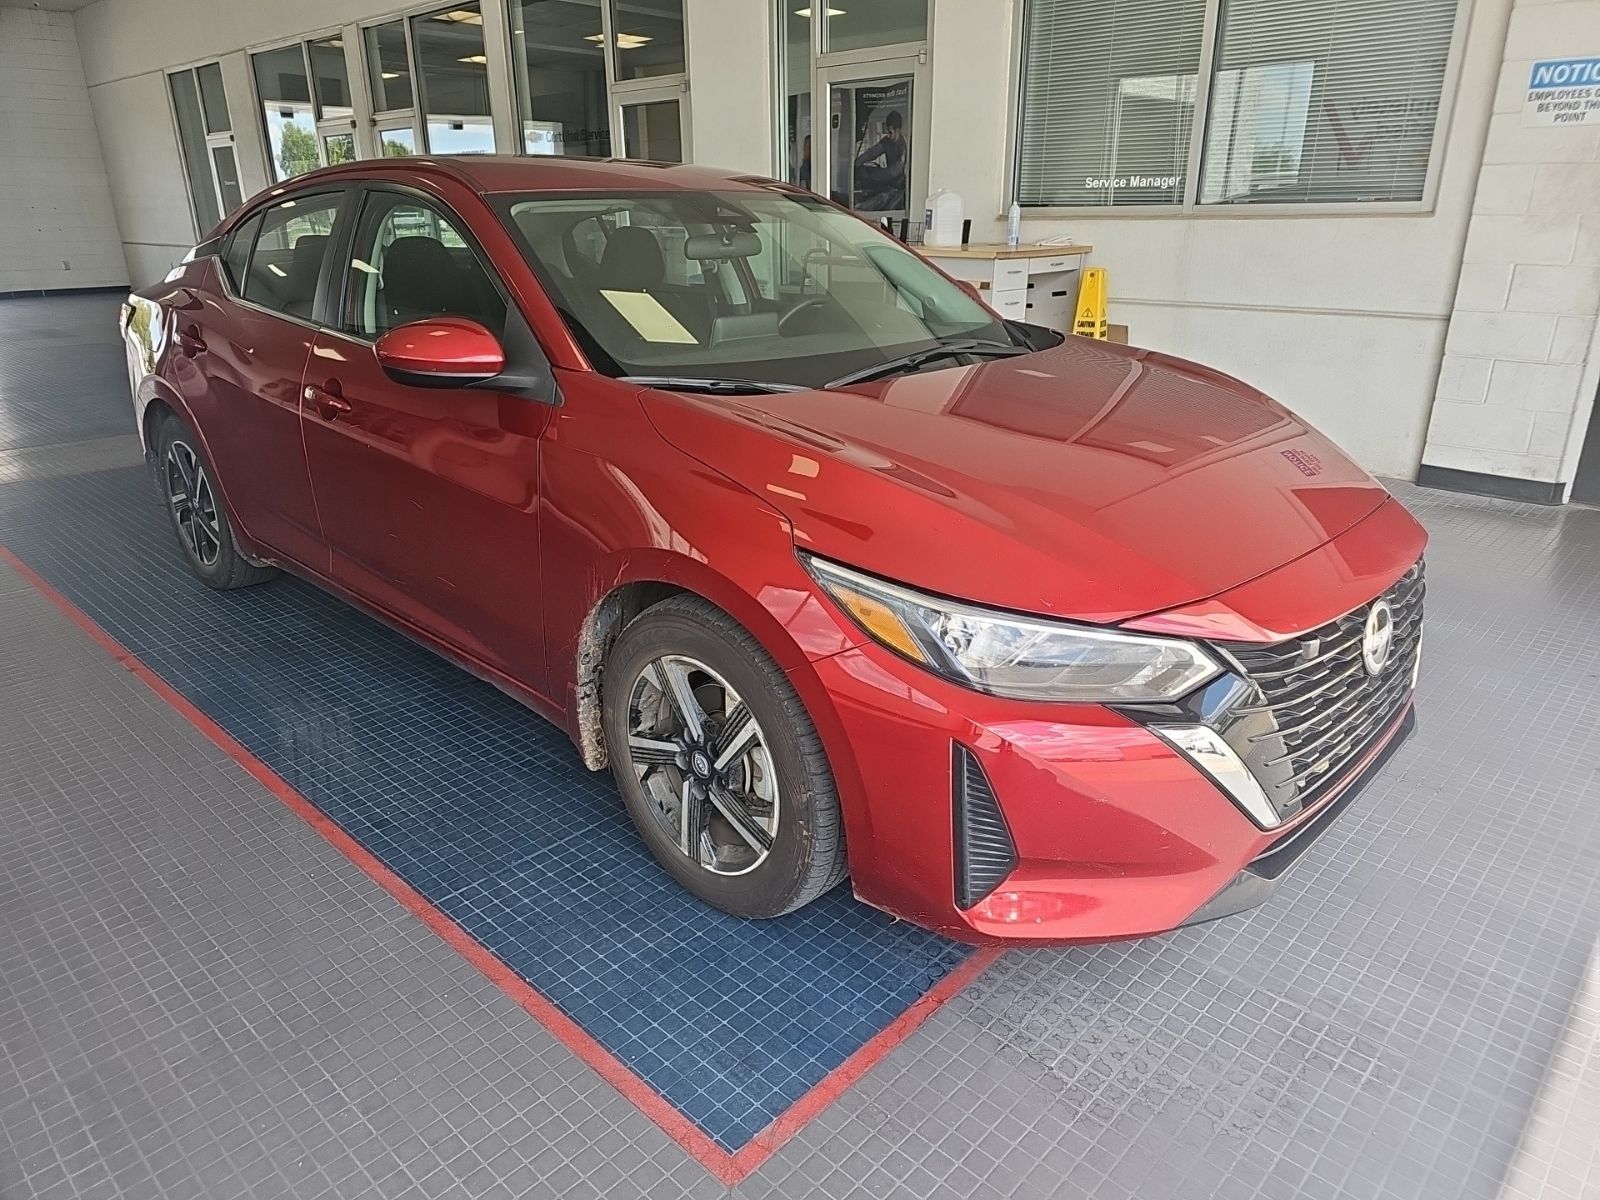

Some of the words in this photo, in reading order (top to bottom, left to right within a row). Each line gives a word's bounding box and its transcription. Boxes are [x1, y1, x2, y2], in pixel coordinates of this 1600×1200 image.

[1528, 88, 1592, 102] EMPLOYEES
[1537, 101, 1581, 113] BEYOND
[1553, 112, 1587, 123] POINT
[1085, 176, 1127, 189] Service
[1129, 175, 1182, 189] Manager
[1076, 320, 1096, 328] CAUTION
